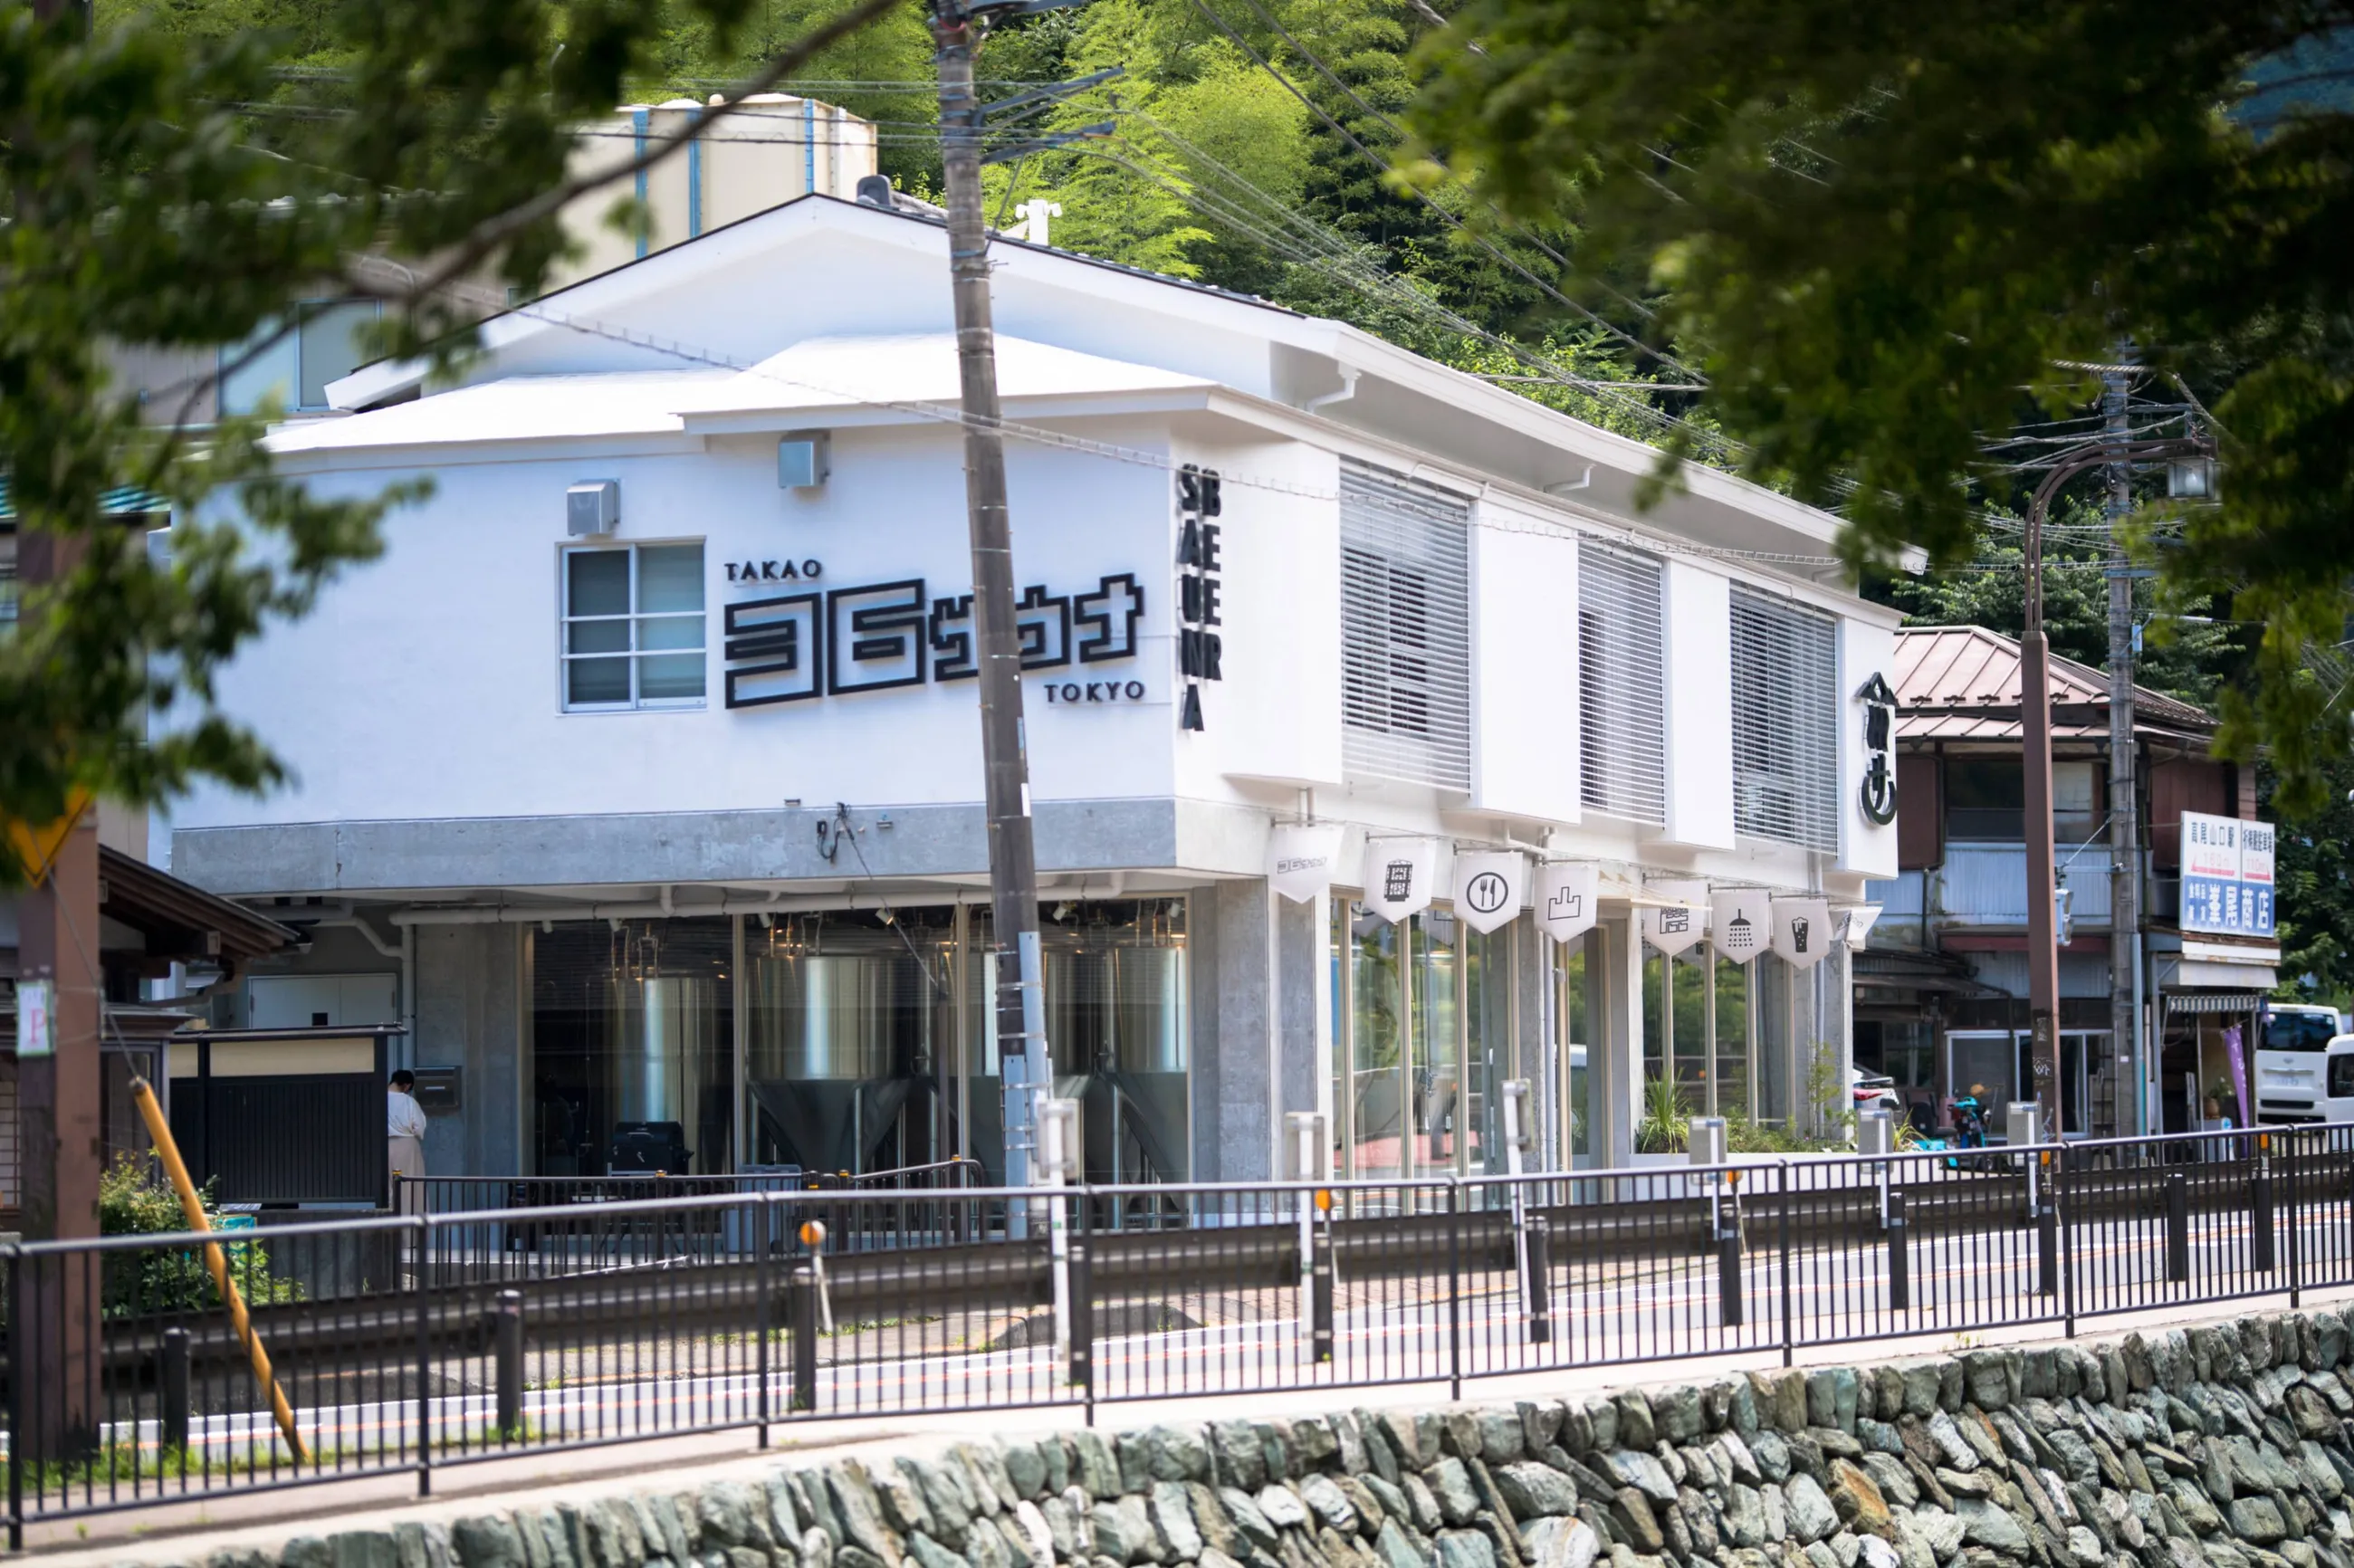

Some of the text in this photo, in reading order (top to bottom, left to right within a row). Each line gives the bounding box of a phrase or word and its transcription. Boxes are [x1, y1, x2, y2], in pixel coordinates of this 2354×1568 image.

[724, 559, 822, 582] TAKAO
[1179, 463, 1205, 731] SAUNA
[1201, 468, 1222, 681] BEER
[1044, 680, 1144, 703] TOKYO
